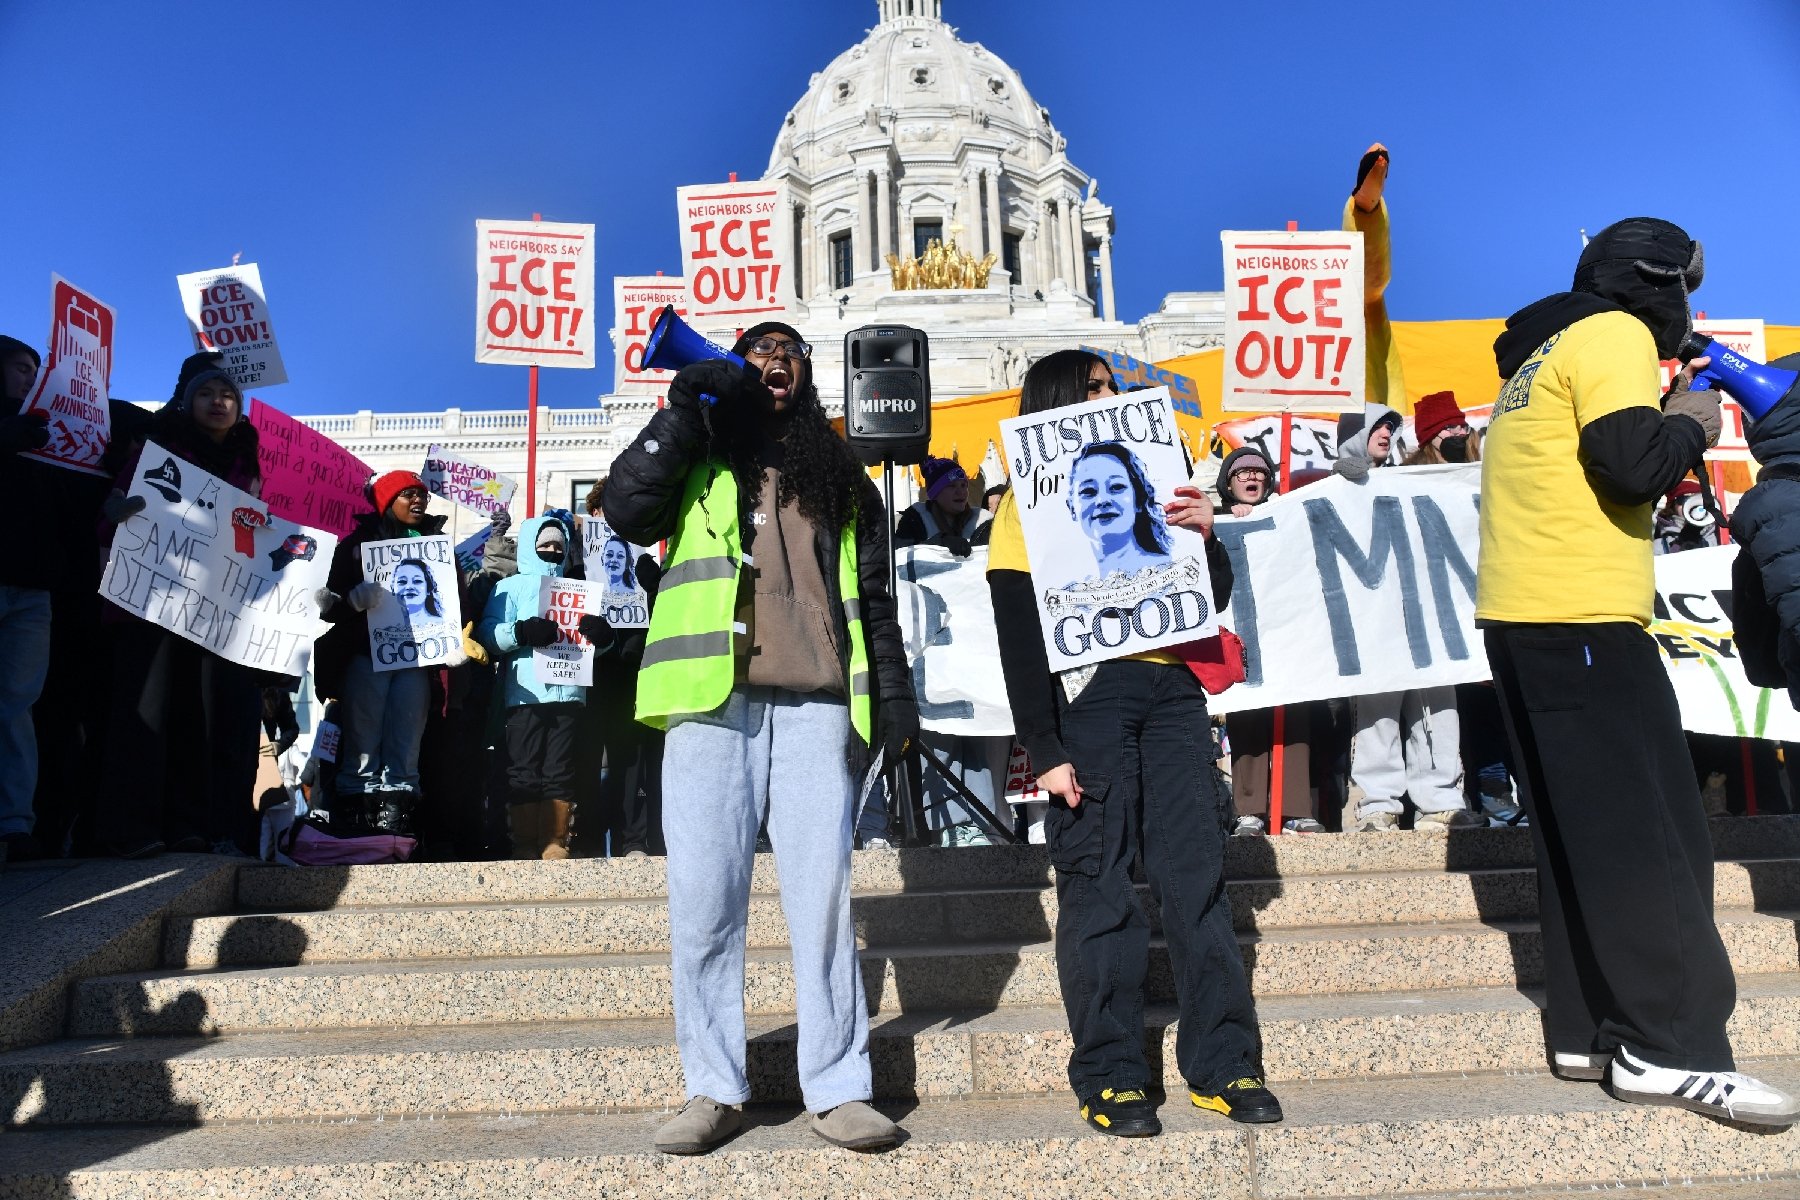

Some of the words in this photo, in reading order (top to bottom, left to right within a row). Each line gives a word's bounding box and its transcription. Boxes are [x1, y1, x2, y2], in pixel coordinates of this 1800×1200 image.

[689, 204, 753, 219] NEIGHBORS
[756, 202, 776, 213] SAY
[489, 240, 557, 255] NEIGHBORS
[561, 244, 583, 256] SAY
[691, 219, 773, 260] ICE
[1236, 256, 1318, 271] NEIGHBORS
[1323, 258, 1349, 270] SAY
[489, 255, 576, 302] ICE
[693, 264, 781, 304] OUT!
[199, 282, 246, 307] ICE
[624, 293, 677, 303] NEIGHBORS
[1237, 275, 1343, 329] ICE
[200, 302, 254, 327] OUT
[487, 298, 584, 347] OUT!
[195, 321, 270, 349] NOW!
[229, 354, 248, 365] WE
[252, 361, 266, 372] US
[1235, 330, 1353, 386] OUT!
[1722, 352, 1749, 370] PYLE
[75, 360, 93, 383] I.C.E.
[1144, 362, 1191, 395] ICE
[70, 379, 87, 400] OUT
[89, 384, 98, 403] OF
[50, 393, 105, 426] MINNESOTA
[859, 398, 917, 413] MIPRO
[1014, 398, 1174, 478] JUSTICE
[427, 459, 497, 481] EDUCATION
[451, 474, 475, 487] NOT
[1027, 463, 1065, 510] for
[366, 540, 451, 572] JUSTICE
[586, 540, 603, 557] for
[118, 513, 210, 582] SAME
[221, 554, 309, 617] THING,
[107, 550, 242, 651] DIFFRENT
[242, 623, 309, 668] HAT
[550, 591, 586, 609] ICE
[1054, 589, 1209, 657] GOOD
[546, 661, 570, 670] KEEP
[553, 670, 576, 679] SAFE!
